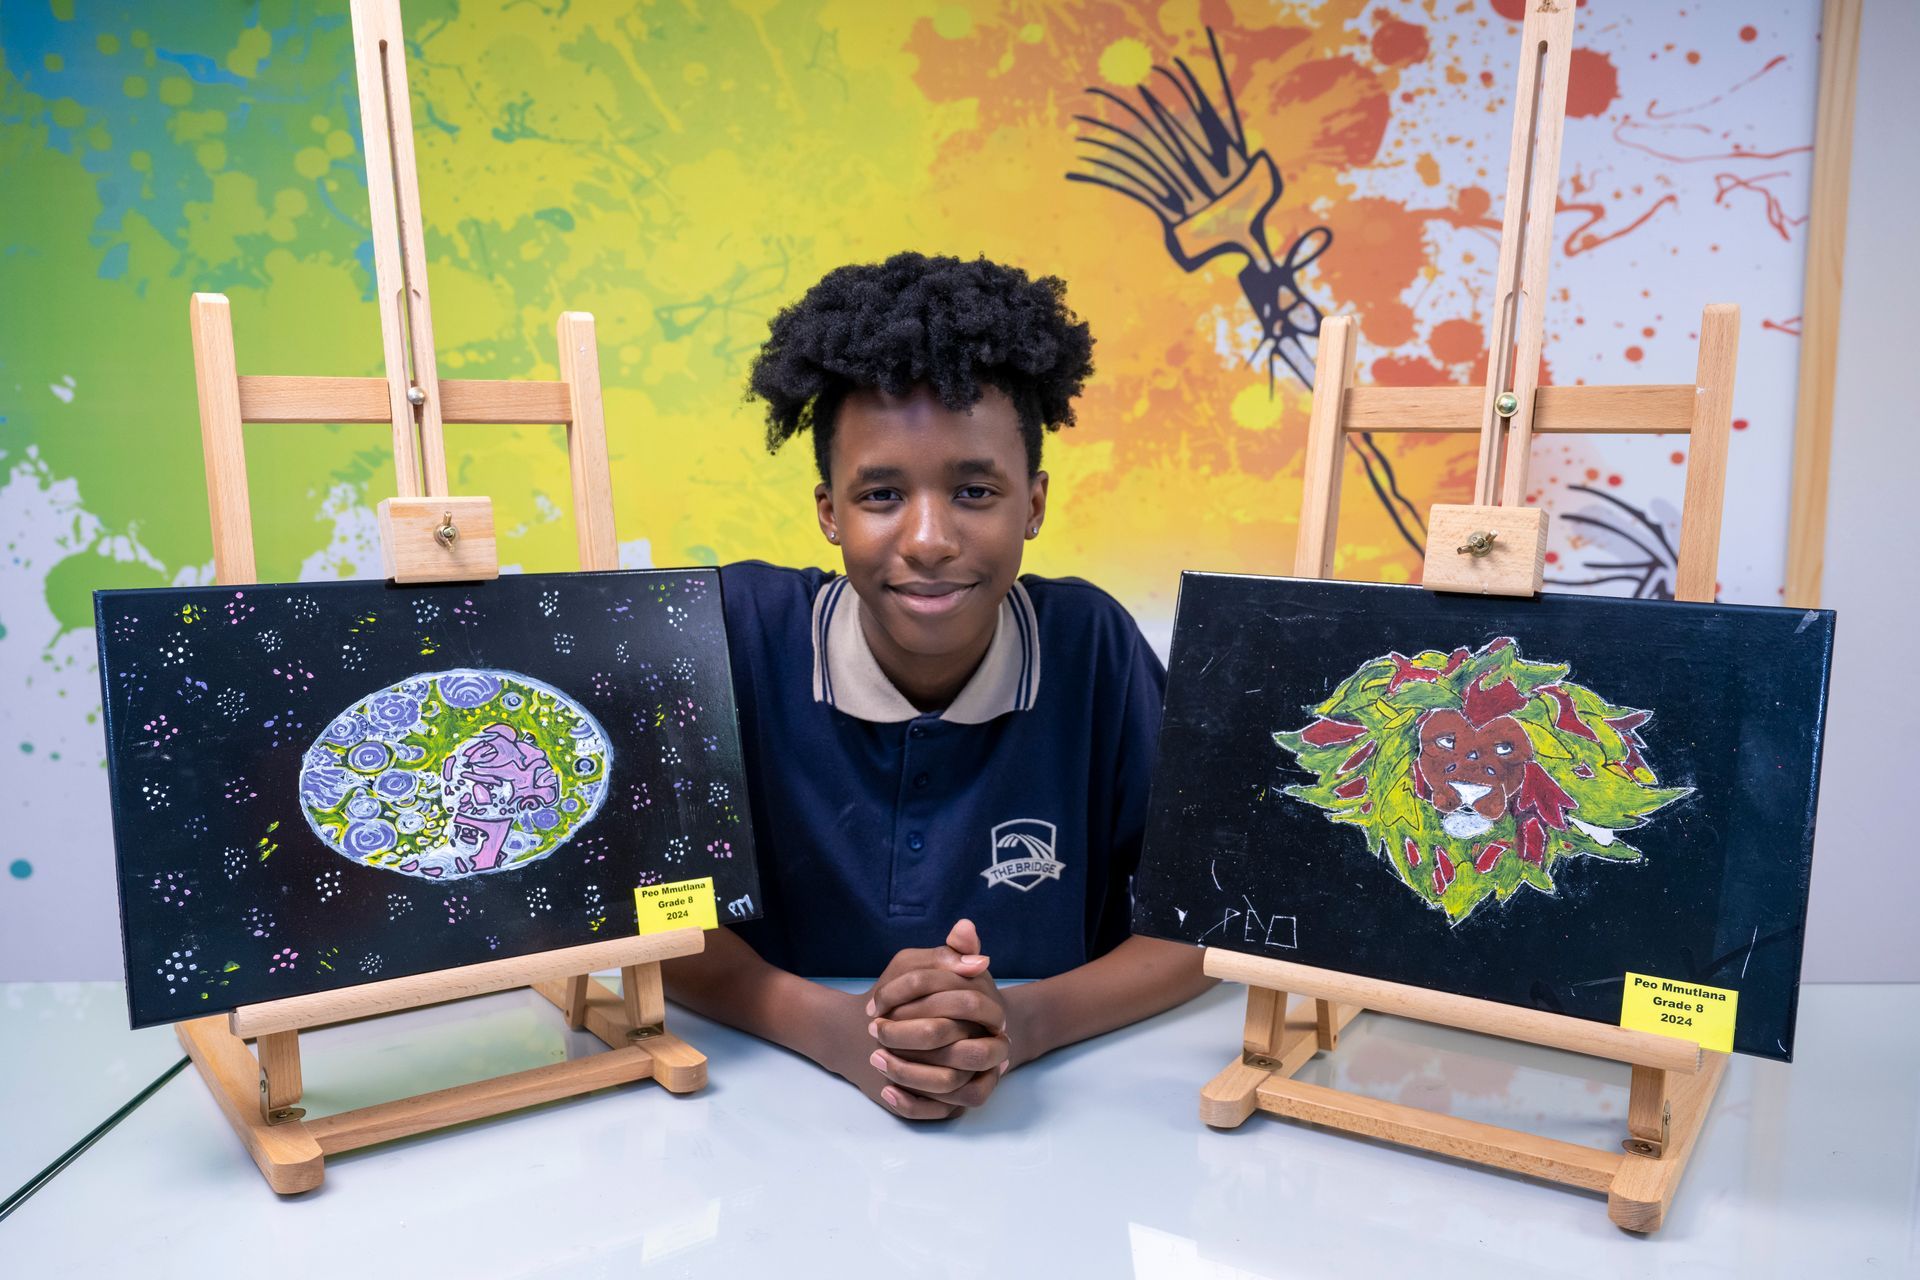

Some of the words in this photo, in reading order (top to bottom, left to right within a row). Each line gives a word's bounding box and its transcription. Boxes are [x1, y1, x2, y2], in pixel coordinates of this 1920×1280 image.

[990, 864, 1015, 880] THE
[1015, 862, 1057, 875] BRIDGE
[642, 889, 659, 898] Peo
[662, 882, 705, 896] Mmutlana
[658, 899, 685, 909] Grade
[688, 896, 694, 904] 8
[666, 910, 689, 920] 2024
[1634, 977, 1658, 989] Peo
[1661, 982, 1726, 1002] Mmutlana
[1653, 996, 1692, 1011] Grade
[1696, 1004, 1704, 1013] 8
[1660, 1013, 1693, 1027] 2024
